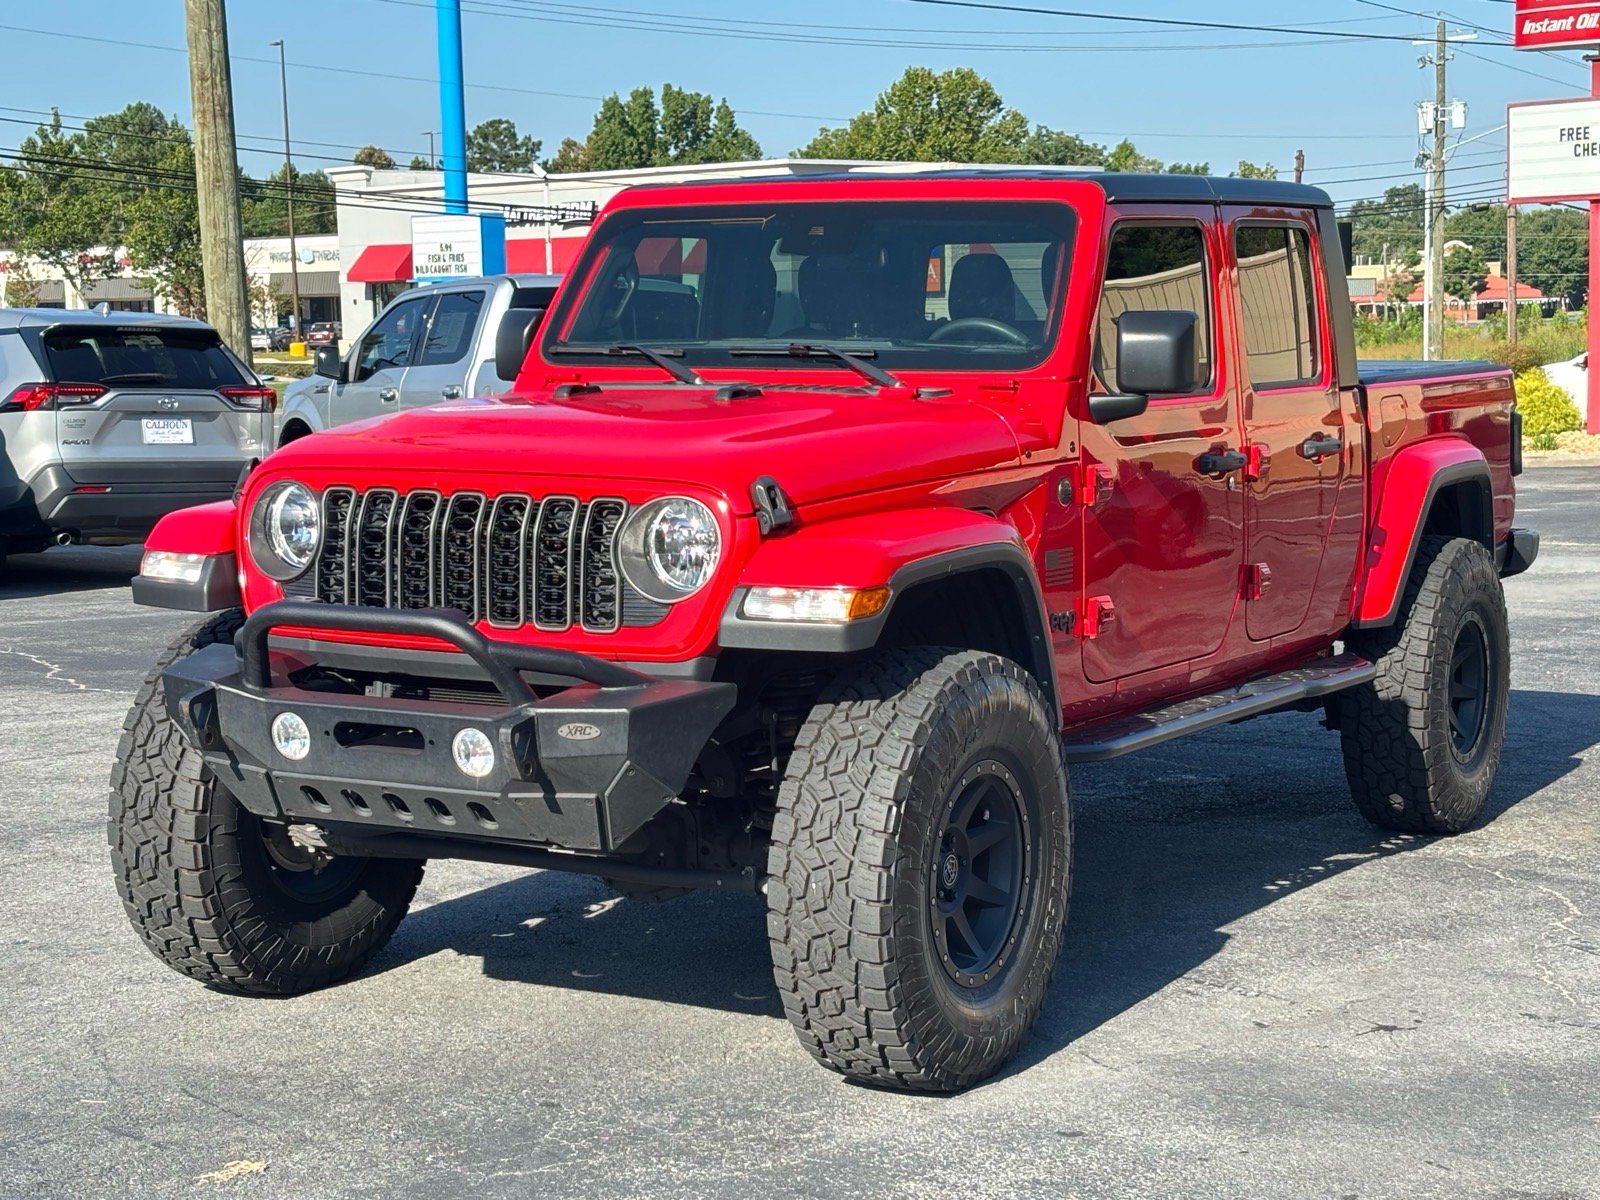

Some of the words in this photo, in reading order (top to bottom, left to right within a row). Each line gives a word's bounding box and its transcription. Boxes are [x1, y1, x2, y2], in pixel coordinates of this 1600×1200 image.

[1522, 16, 1575, 35] Instant
[1559, 126, 1590, 142] FREE
[1573, 142, 1600, 158] CHE
[427, 254, 441, 263] FISH
[448, 253, 465, 262] FRIES
[415, 265, 429, 274] WILD
[430, 264, 452, 273] CAUGHT
[454, 264, 467, 273] FISH
[145, 420, 188, 430] CALHOUN
[565, 725, 592, 737] XRC
